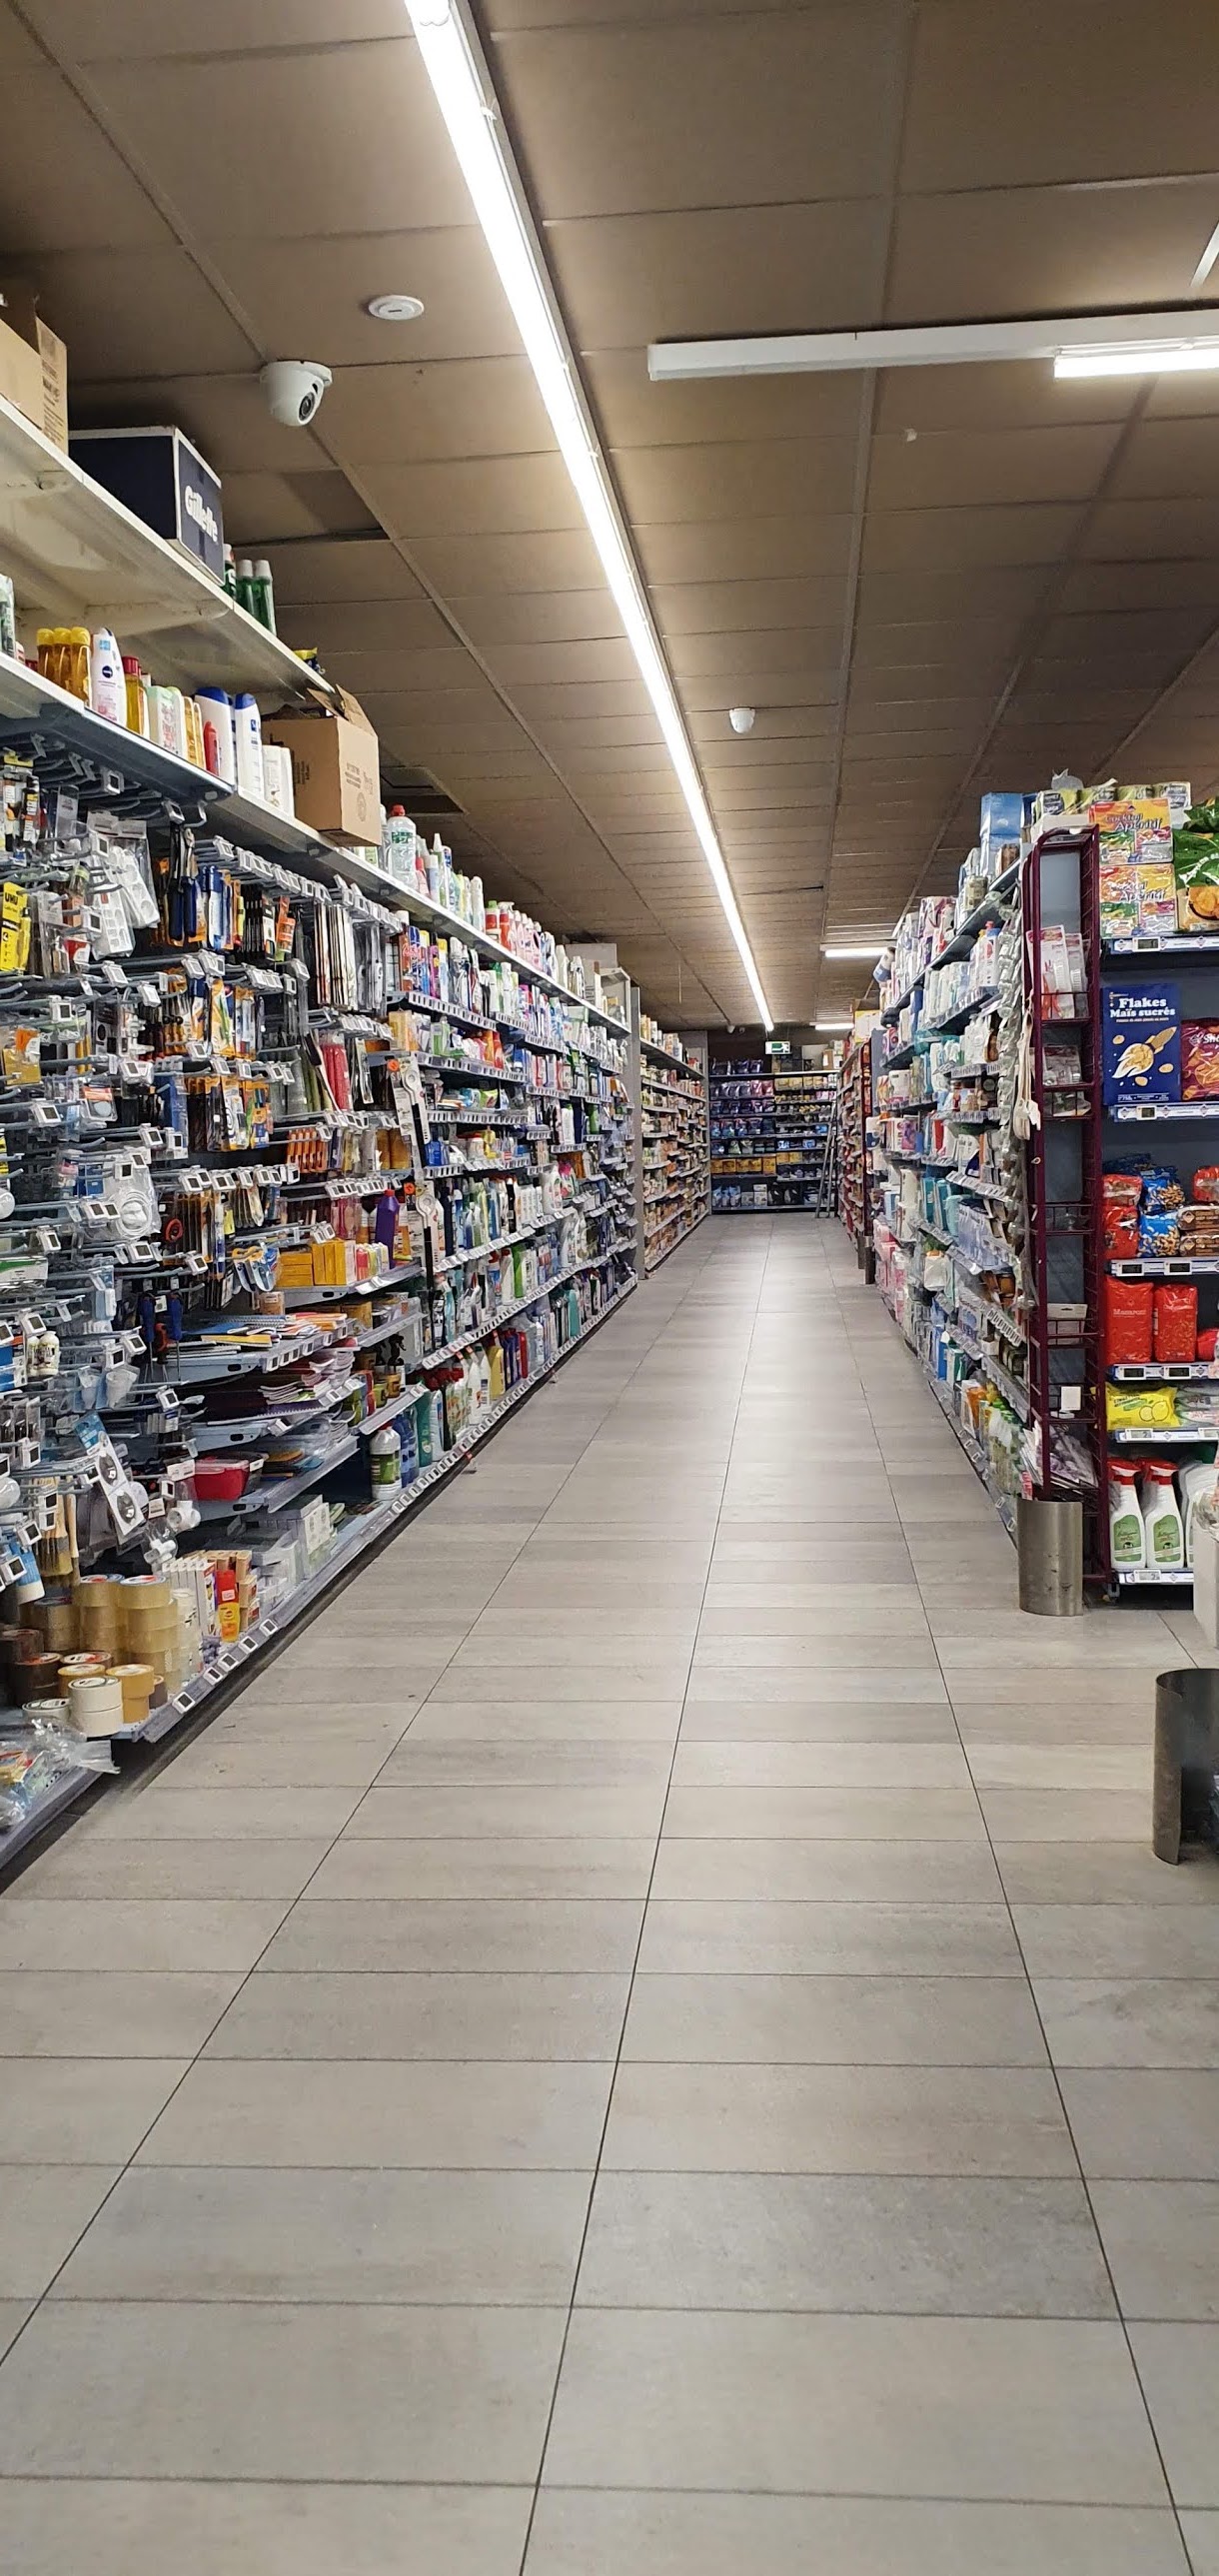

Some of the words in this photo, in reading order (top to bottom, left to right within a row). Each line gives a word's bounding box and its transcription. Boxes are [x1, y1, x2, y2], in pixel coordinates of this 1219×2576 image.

[185, 486, 218, 543] Gillette
[1119, 997, 1167, 1008] Flakes
[1110, 1008, 1137, 1018] Maïs
[1138, 1006, 1176, 1016] sucrés
